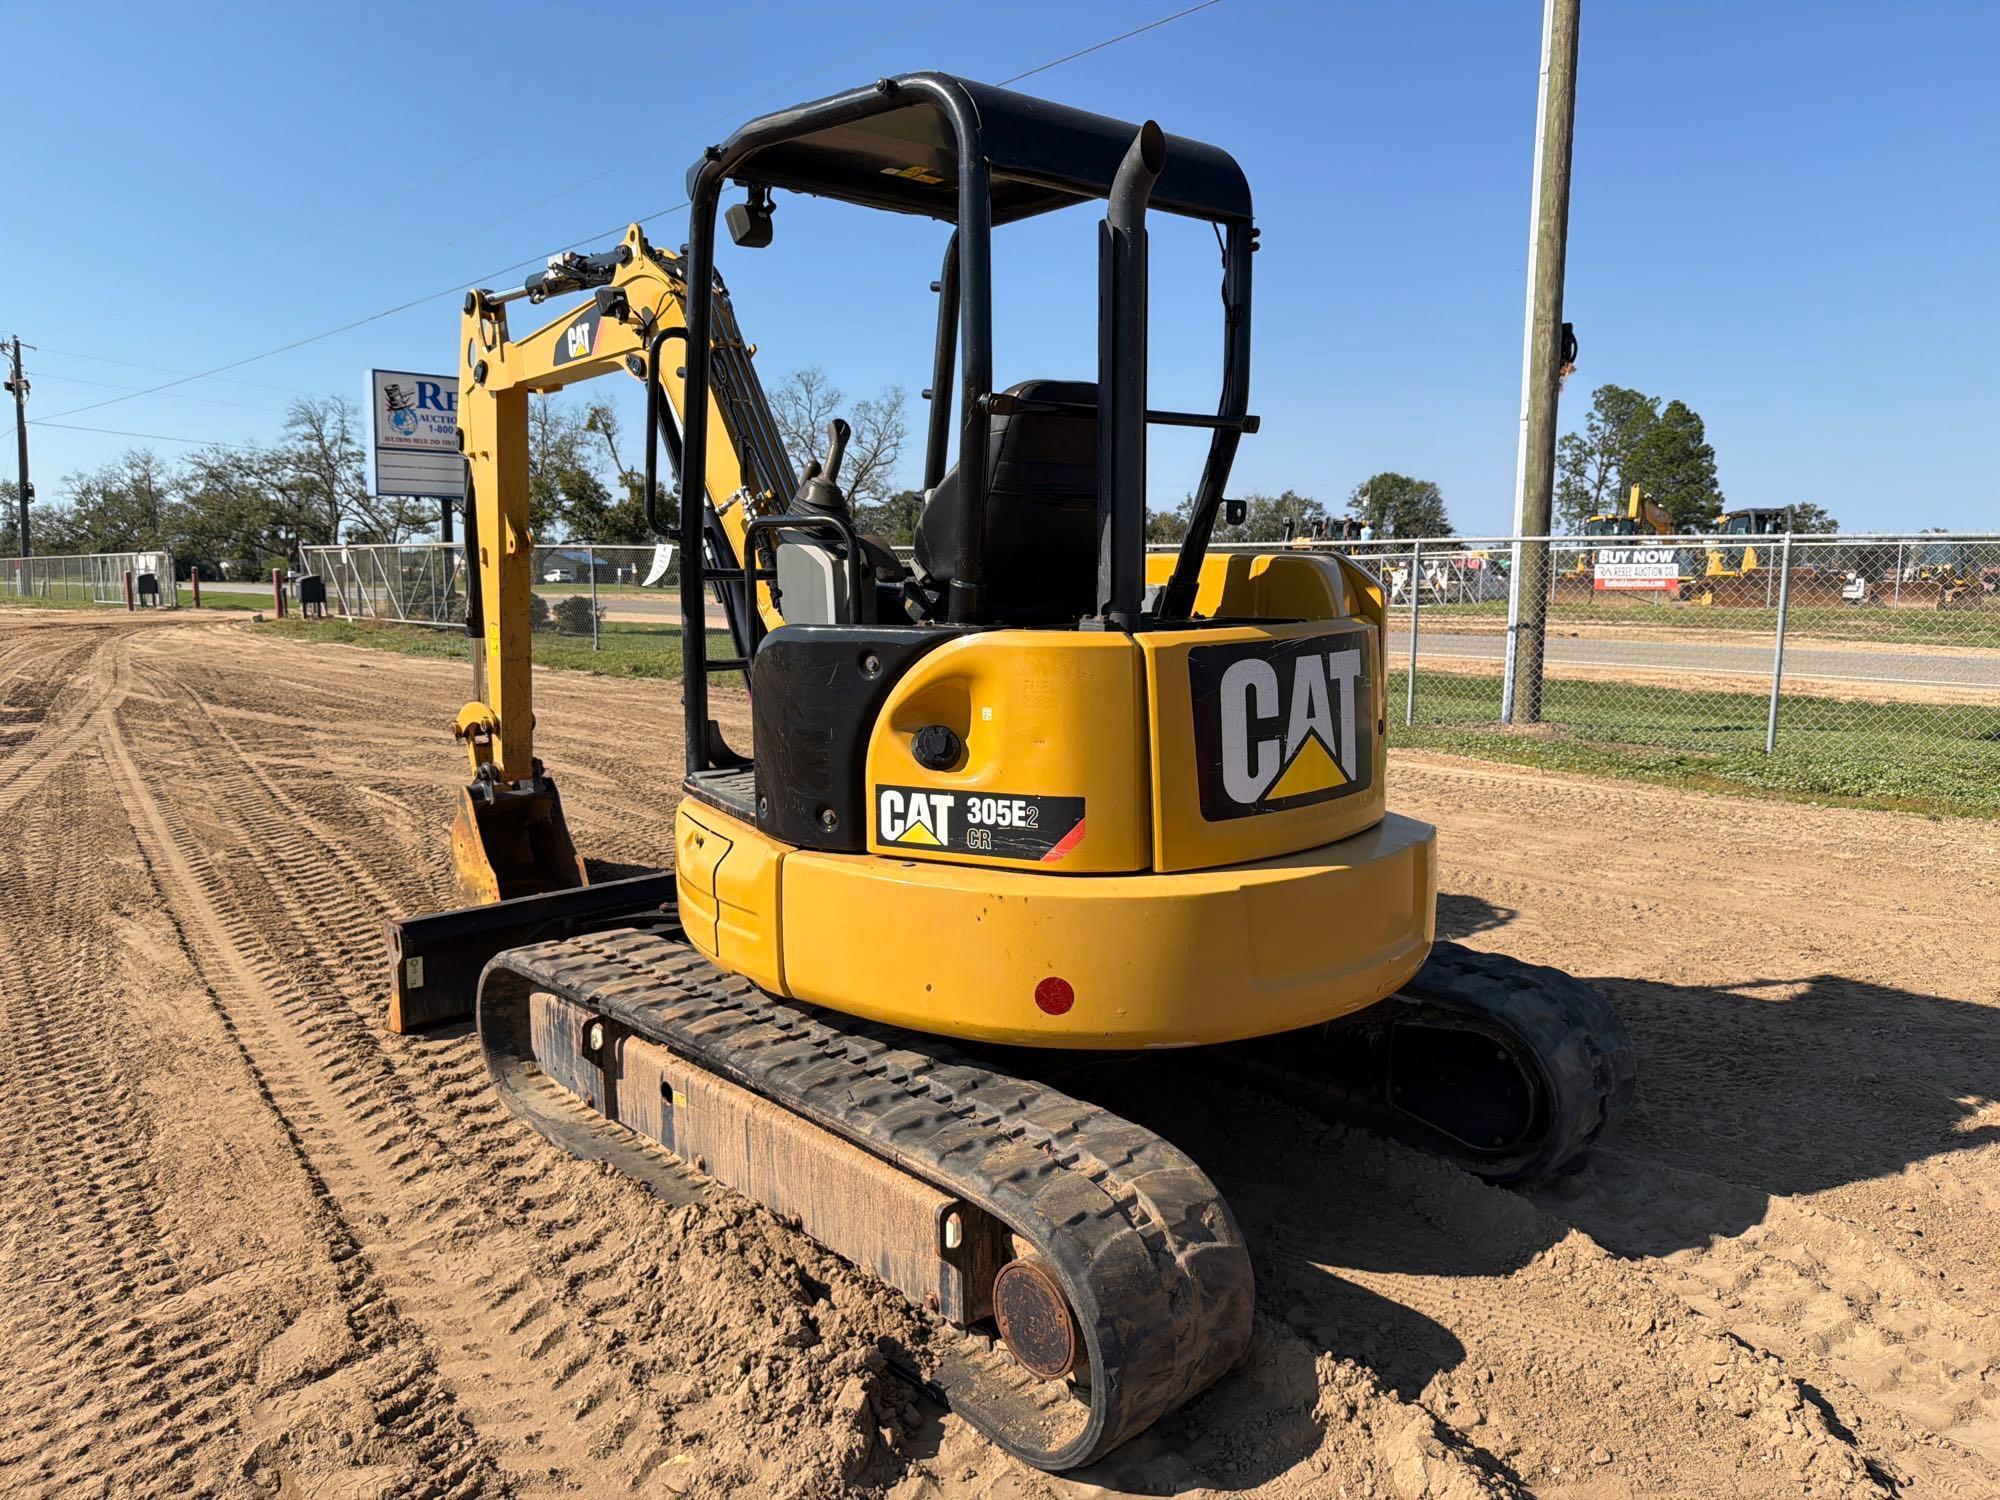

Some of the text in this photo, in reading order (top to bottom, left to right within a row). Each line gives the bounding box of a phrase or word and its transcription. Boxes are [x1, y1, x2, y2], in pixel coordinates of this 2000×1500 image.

[567, 322, 590, 358] CAT
[416, 381, 458, 411] RE
[420, 415, 457, 424] AUCTIO
[429, 425, 453, 434] 1-800
[1598, 549, 1674, 564] BUY NOW
[1613, 566, 1632, 577] REBEL
[1634, 566, 1663, 577] AUCTION
[1220, 648, 1362, 804] CAT
[880, 789, 954, 847] CAT
[966, 797, 1039, 828] 305E2
[966, 828, 992, 849] CR
